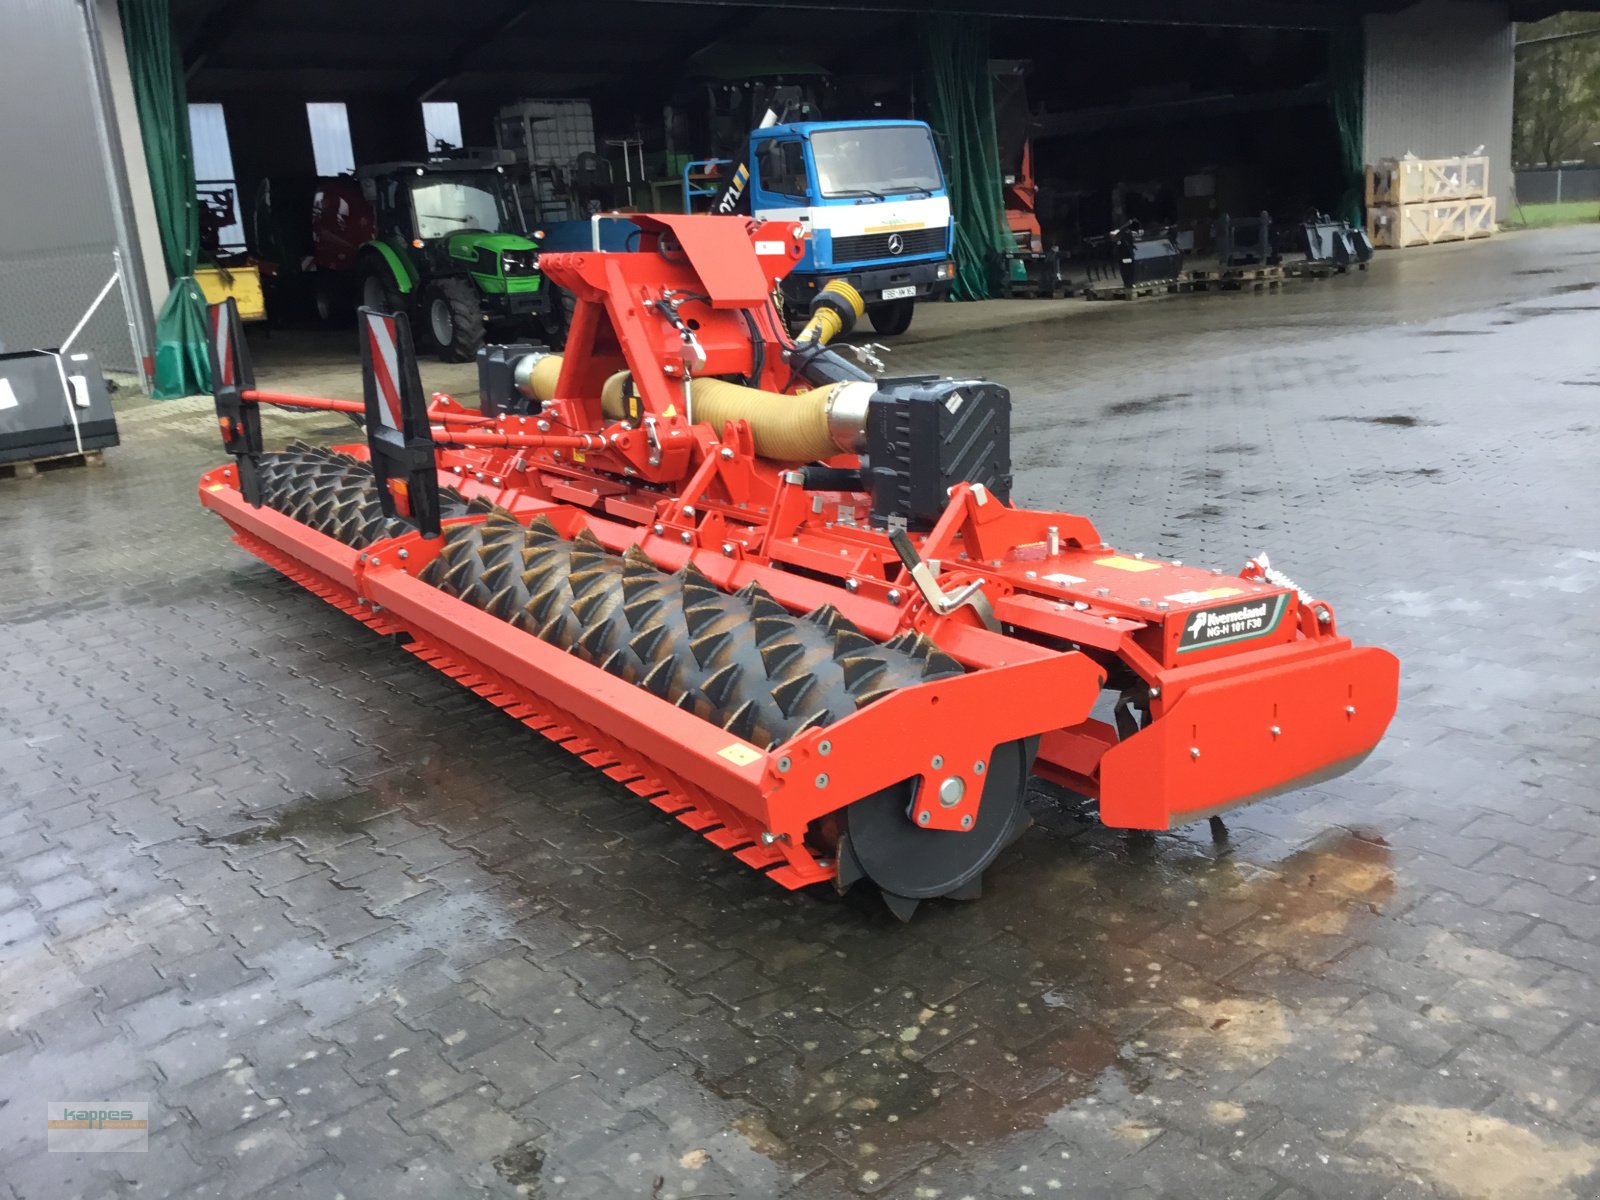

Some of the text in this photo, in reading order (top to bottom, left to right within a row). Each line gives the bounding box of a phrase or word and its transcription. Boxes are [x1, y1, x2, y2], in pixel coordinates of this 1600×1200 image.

[1207, 603, 1267, 626] Kverneland
[1207, 624, 1230, 638] NG-H
[1231, 620, 1246, 633] 101
